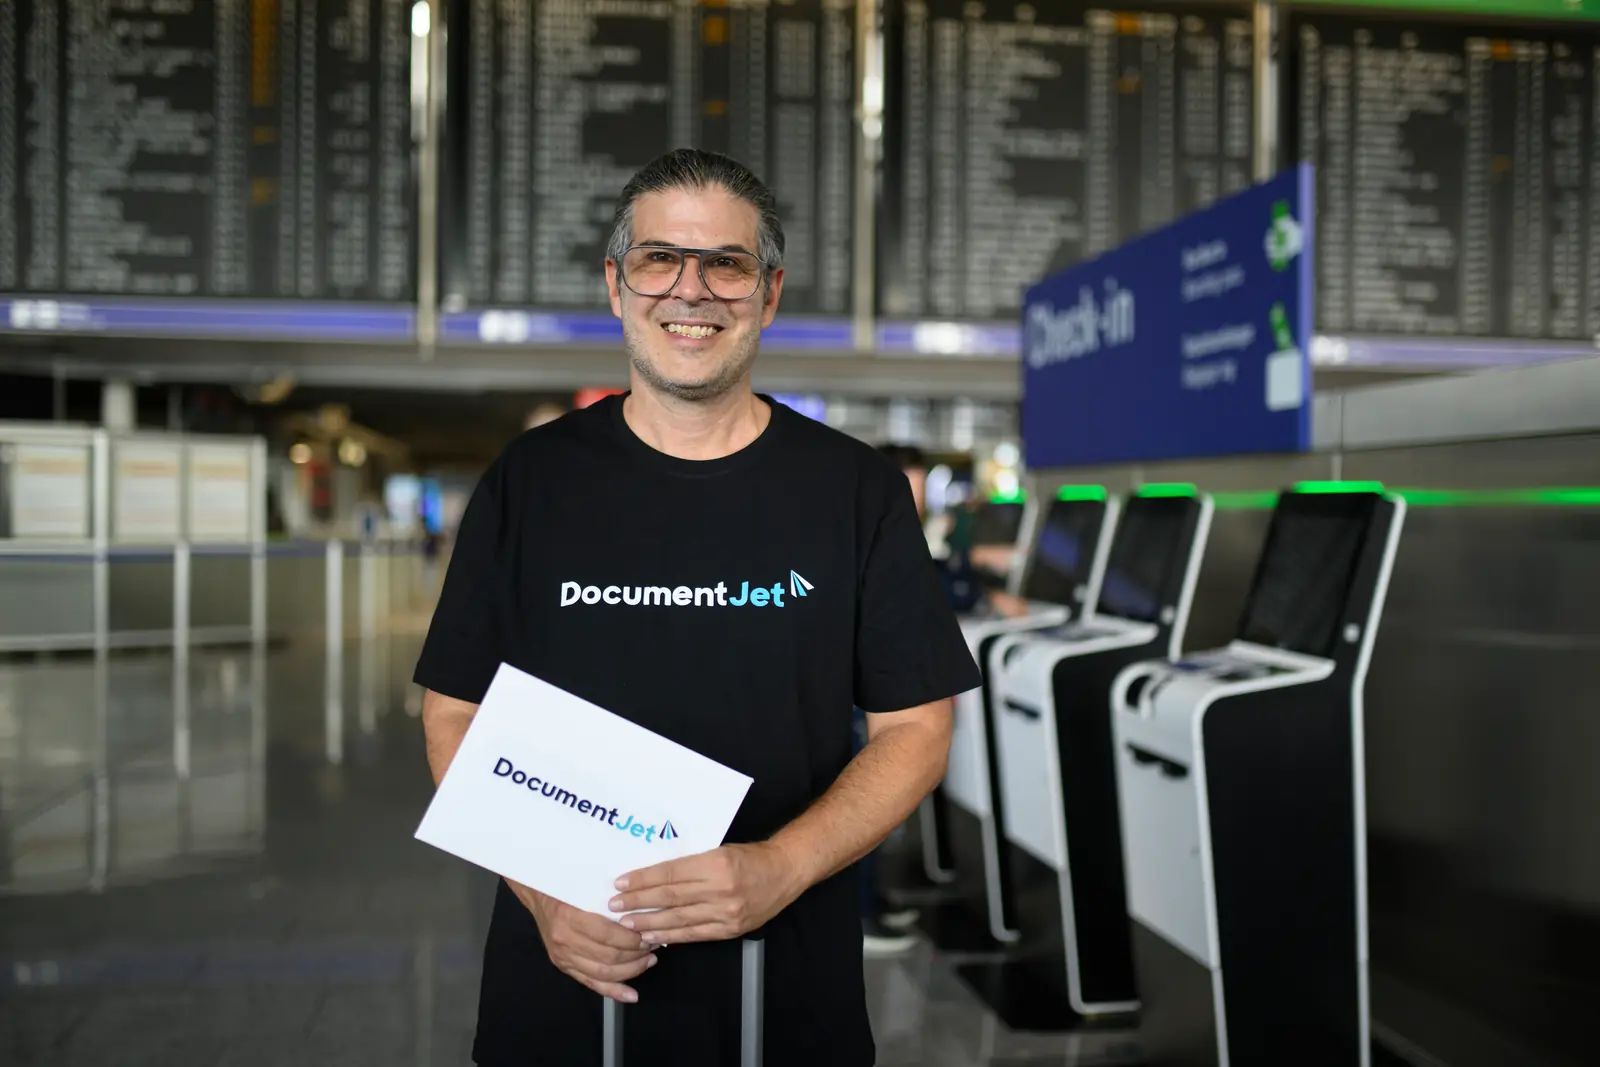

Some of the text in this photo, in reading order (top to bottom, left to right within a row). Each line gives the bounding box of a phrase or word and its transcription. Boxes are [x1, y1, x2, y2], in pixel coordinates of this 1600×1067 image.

[1027, 278, 1135, 368] Check-in
[560, 581, 785, 607] DocumentJet
[492, 757, 656, 843] DocumentJet
